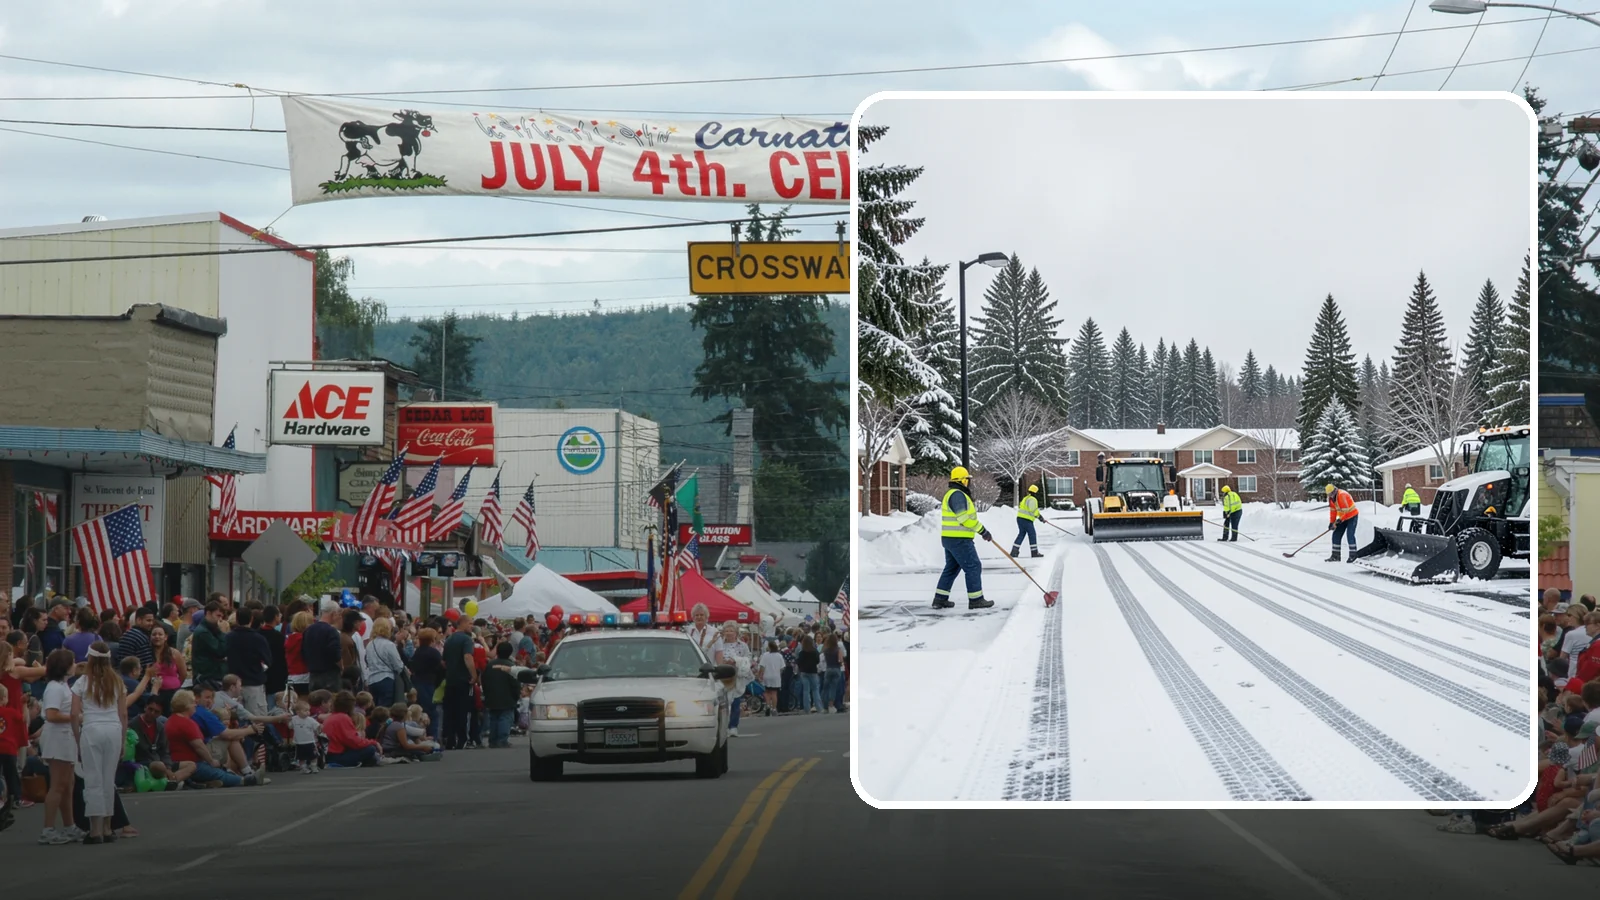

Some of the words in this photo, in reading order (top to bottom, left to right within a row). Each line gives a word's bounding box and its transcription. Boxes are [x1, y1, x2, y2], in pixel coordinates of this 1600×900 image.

[481, 141, 604, 192] JULY
[632, 150, 746, 197] 4th.
[696, 254, 850, 280] CROSSWA
[282, 380, 373, 420] ACE
[405, 409, 454, 422] CEDAR
[461, 409, 485, 422] LOG
[283, 421, 370, 437] Hardware
[416, 428, 477, 447] Coca-Cola
[353, 467, 385, 479] Simpl
[83, 485, 94, 494] St.
[95, 485, 124, 495] Vincent
[126, 486, 136, 494] de
[138, 486, 155, 495] Paul
[687, 526, 741, 535] CRNATION
[699, 535, 730, 543] GLASS
